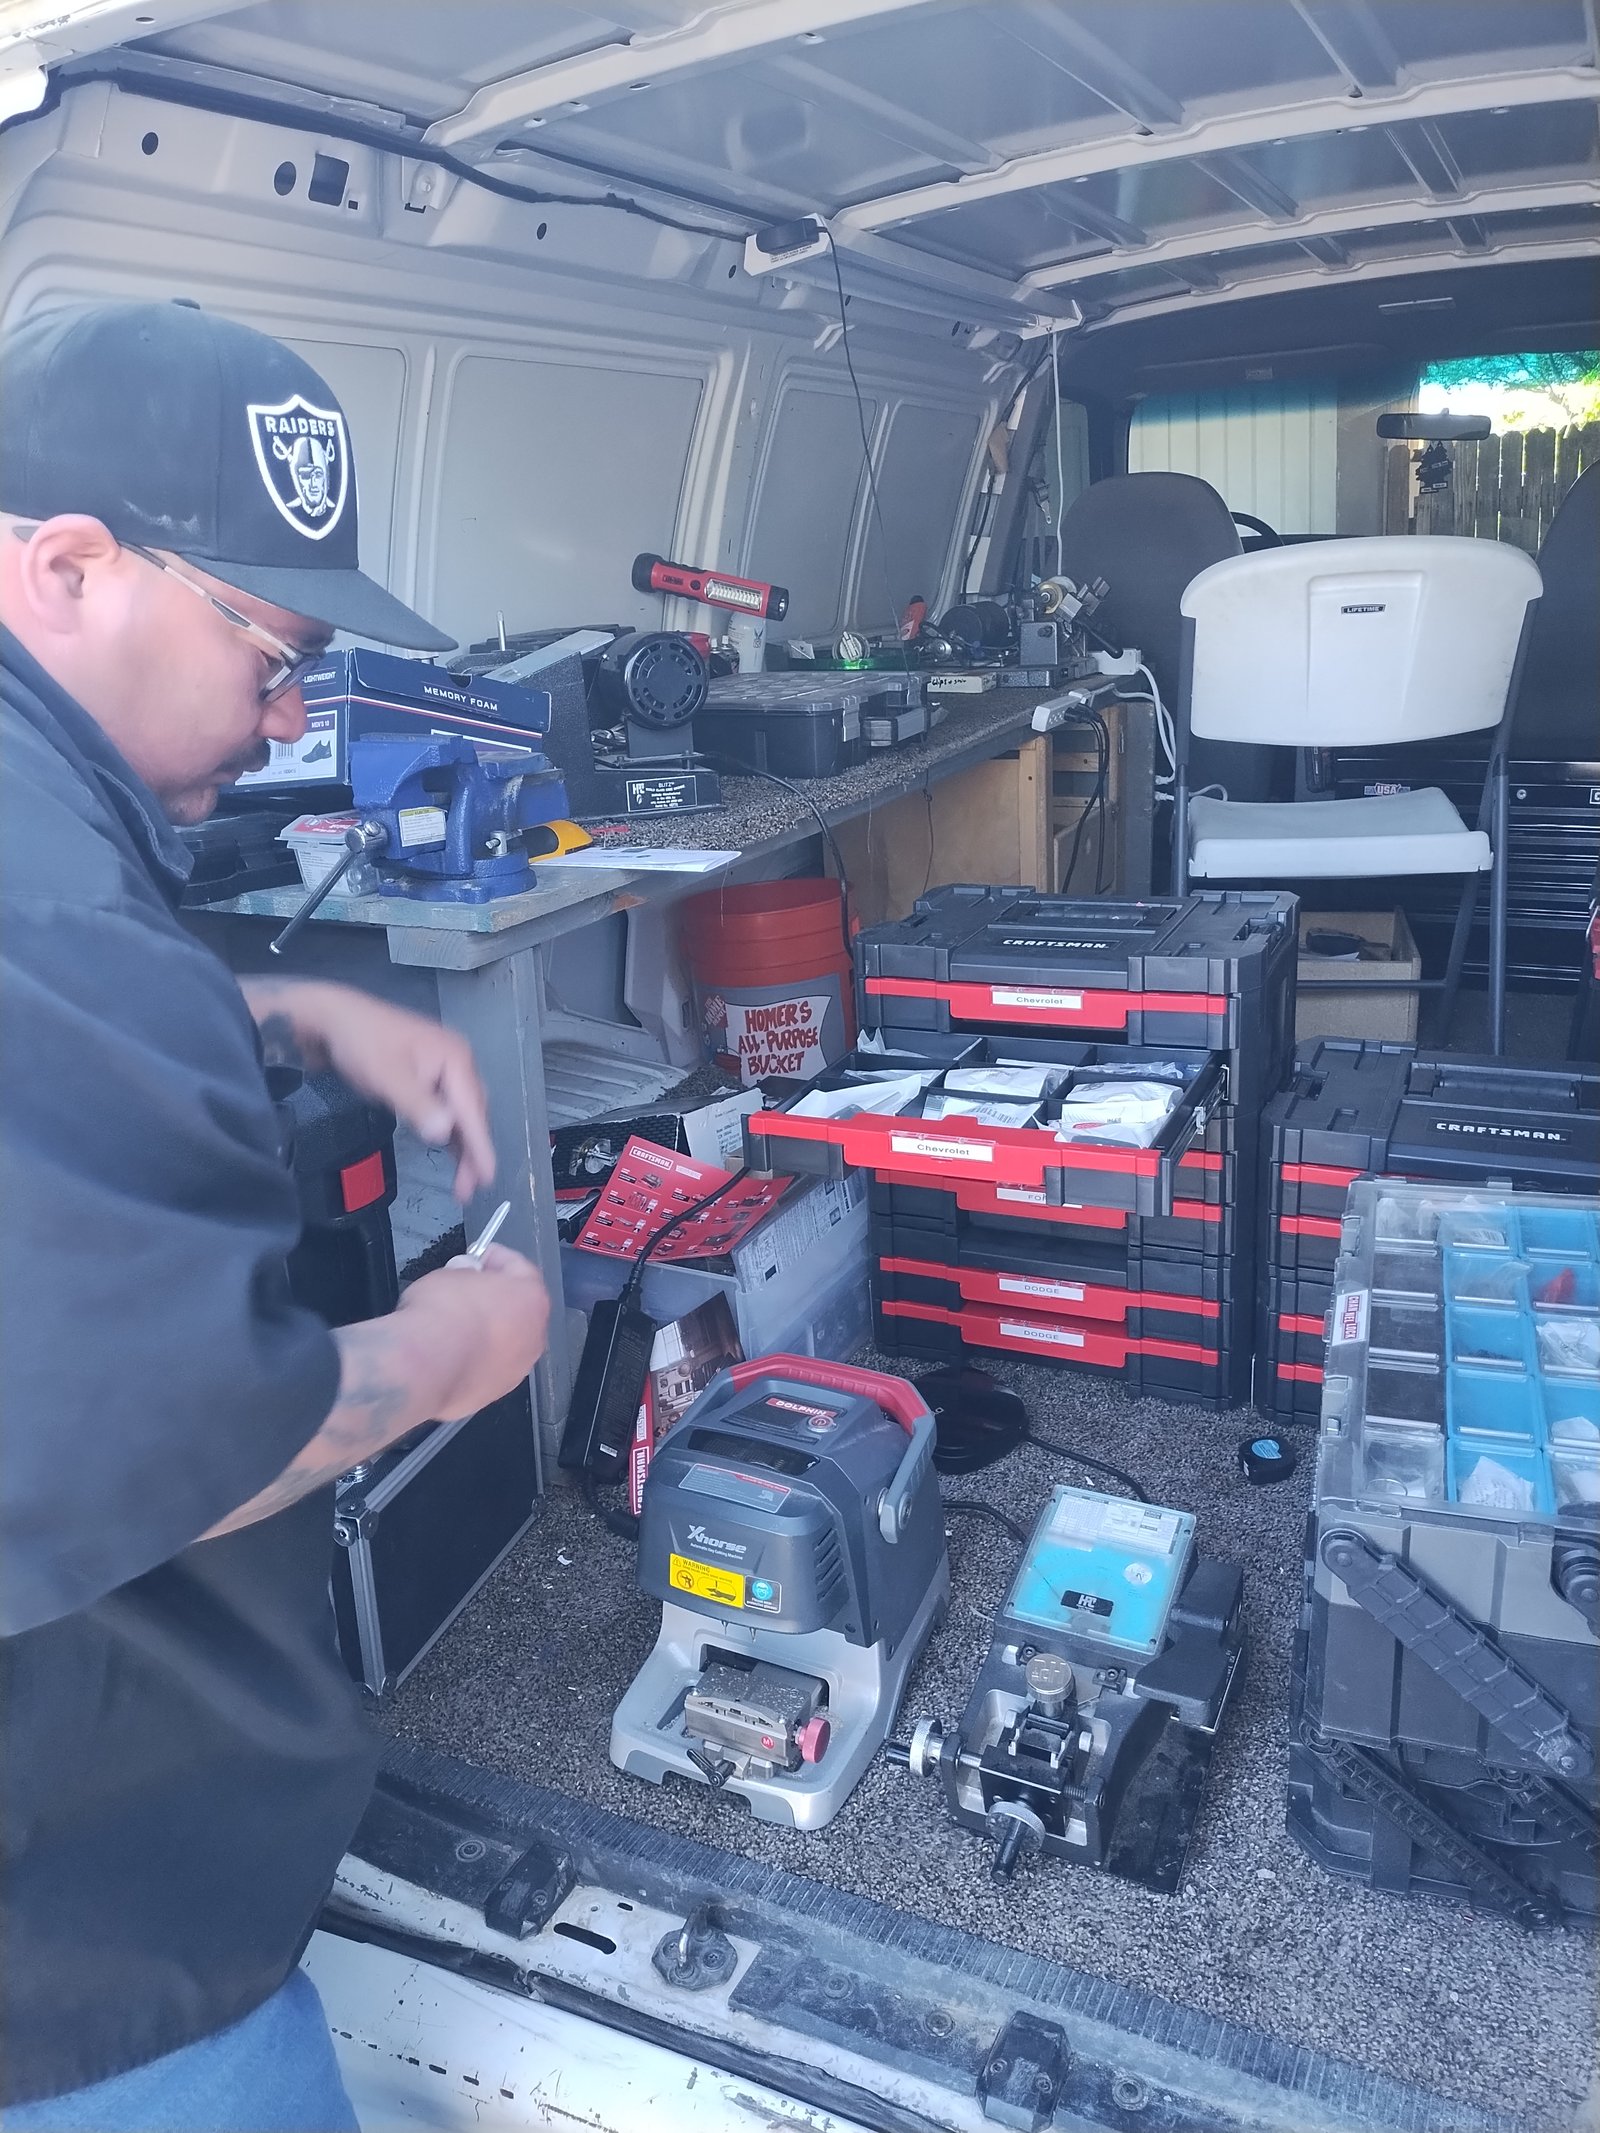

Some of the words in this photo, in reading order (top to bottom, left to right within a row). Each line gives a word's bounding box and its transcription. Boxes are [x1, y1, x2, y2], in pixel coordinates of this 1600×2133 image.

[264, 416, 335, 437] RAIDERS
[423, 685, 467, 703] MEMORY
[470, 697, 498, 711] FOAM
[1377, 785, 1397, 795] USA
[1003, 939, 1106, 949] CRAFTSMAN
[1016, 996, 1063, 1005] Chevrolet
[744, 1000, 813, 1034] HOMER'S
[748, 1051, 805, 1076] BUCKET
[1436, 1122, 1561, 1141] CRAFTSMAN
[917, 1143, 970, 1156] Chevrolet
[632, 1148, 671, 1169] CRAFTSMAN
[1024, 1284, 1060, 1295] DODGE
[1023, 1330, 1059, 1341] DODGE
[775, 1400, 827, 1416] DOLPHIN
[687, 1524, 747, 1554] Xhorse
[682, 1559, 711, 1573] WARNING
